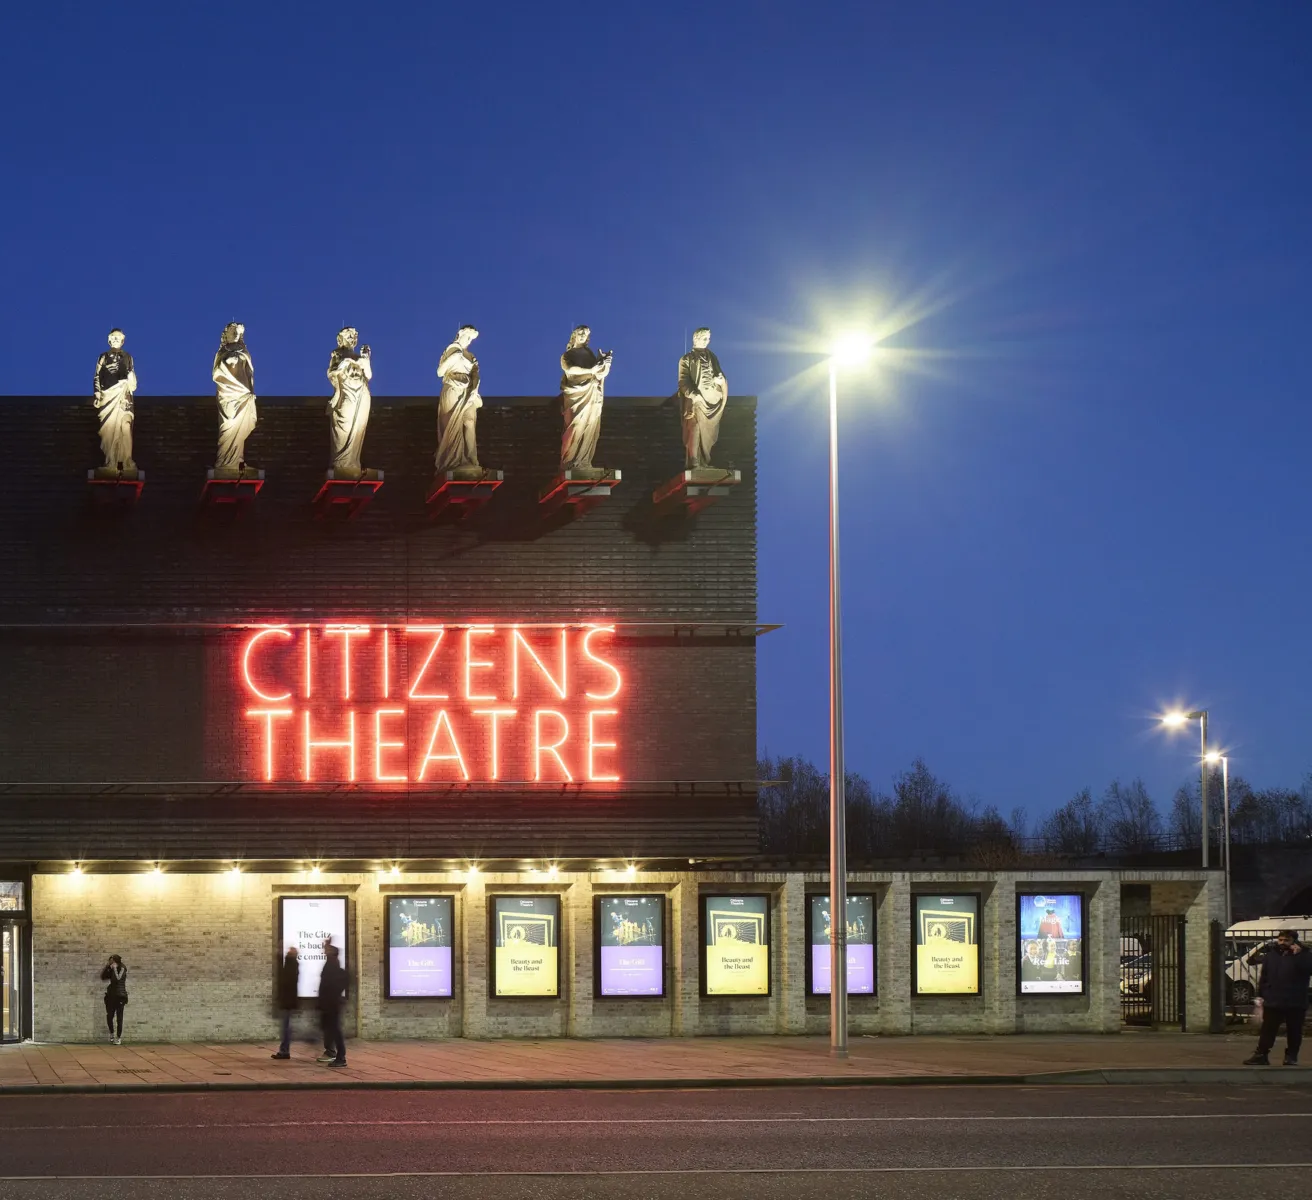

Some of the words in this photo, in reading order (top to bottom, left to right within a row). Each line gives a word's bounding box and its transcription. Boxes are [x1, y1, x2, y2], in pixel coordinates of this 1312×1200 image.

[244, 627, 621, 701] CITIZENS
[246, 709, 620, 782] THEATRE
[297, 930, 313, 938] The
[299, 941, 306, 949] is
[304, 952, 328, 960] comin
[1054, 956, 1070, 965] Life
